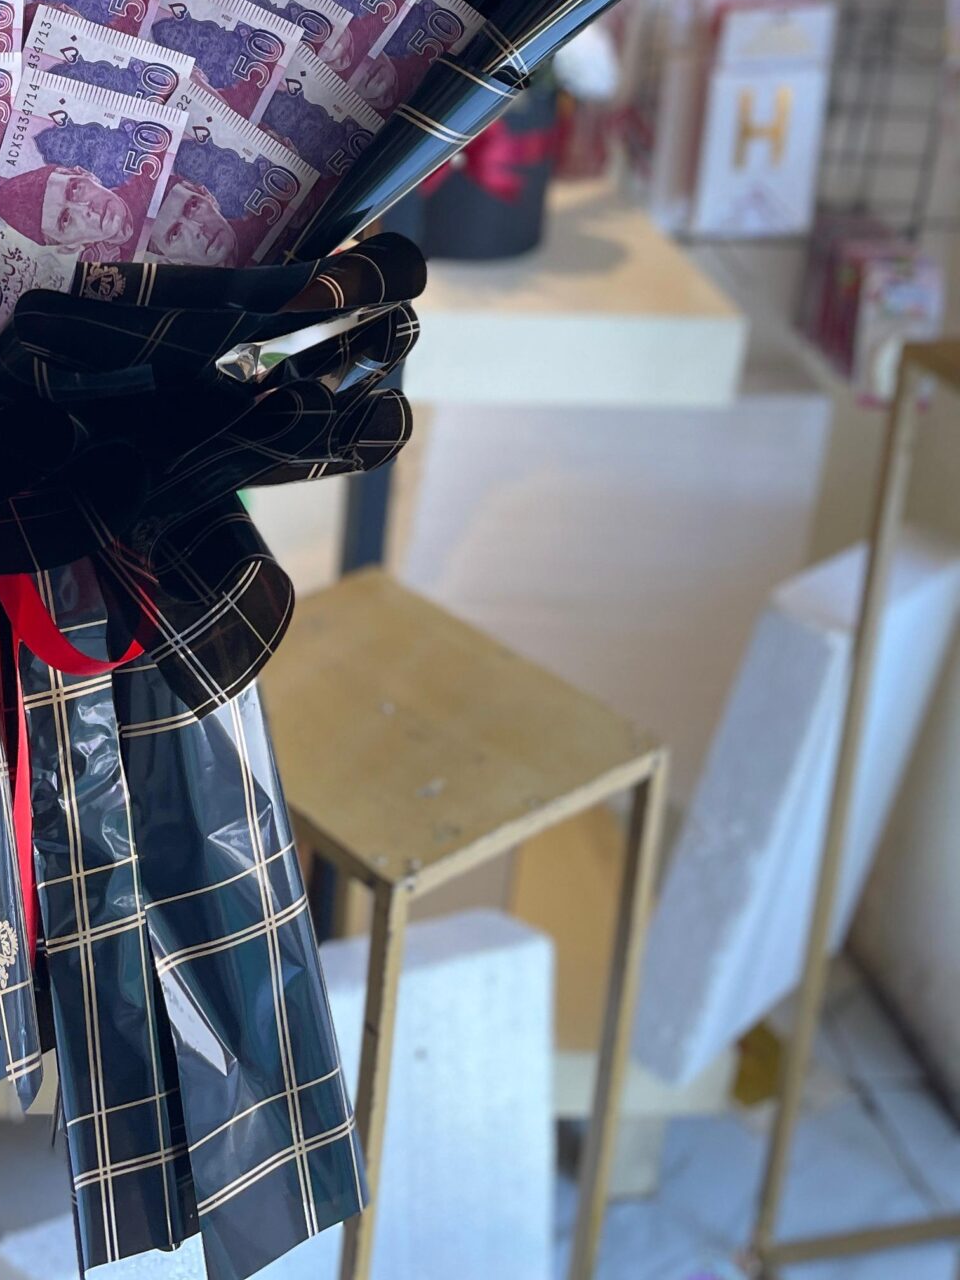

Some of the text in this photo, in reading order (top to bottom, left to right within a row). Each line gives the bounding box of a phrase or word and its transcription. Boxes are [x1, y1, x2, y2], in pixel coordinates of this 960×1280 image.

[232, 29, 284, 89] 50
[123, 121, 172, 180] 50
[732, 86, 792, 167] H
[244, 166, 300, 225] 50
